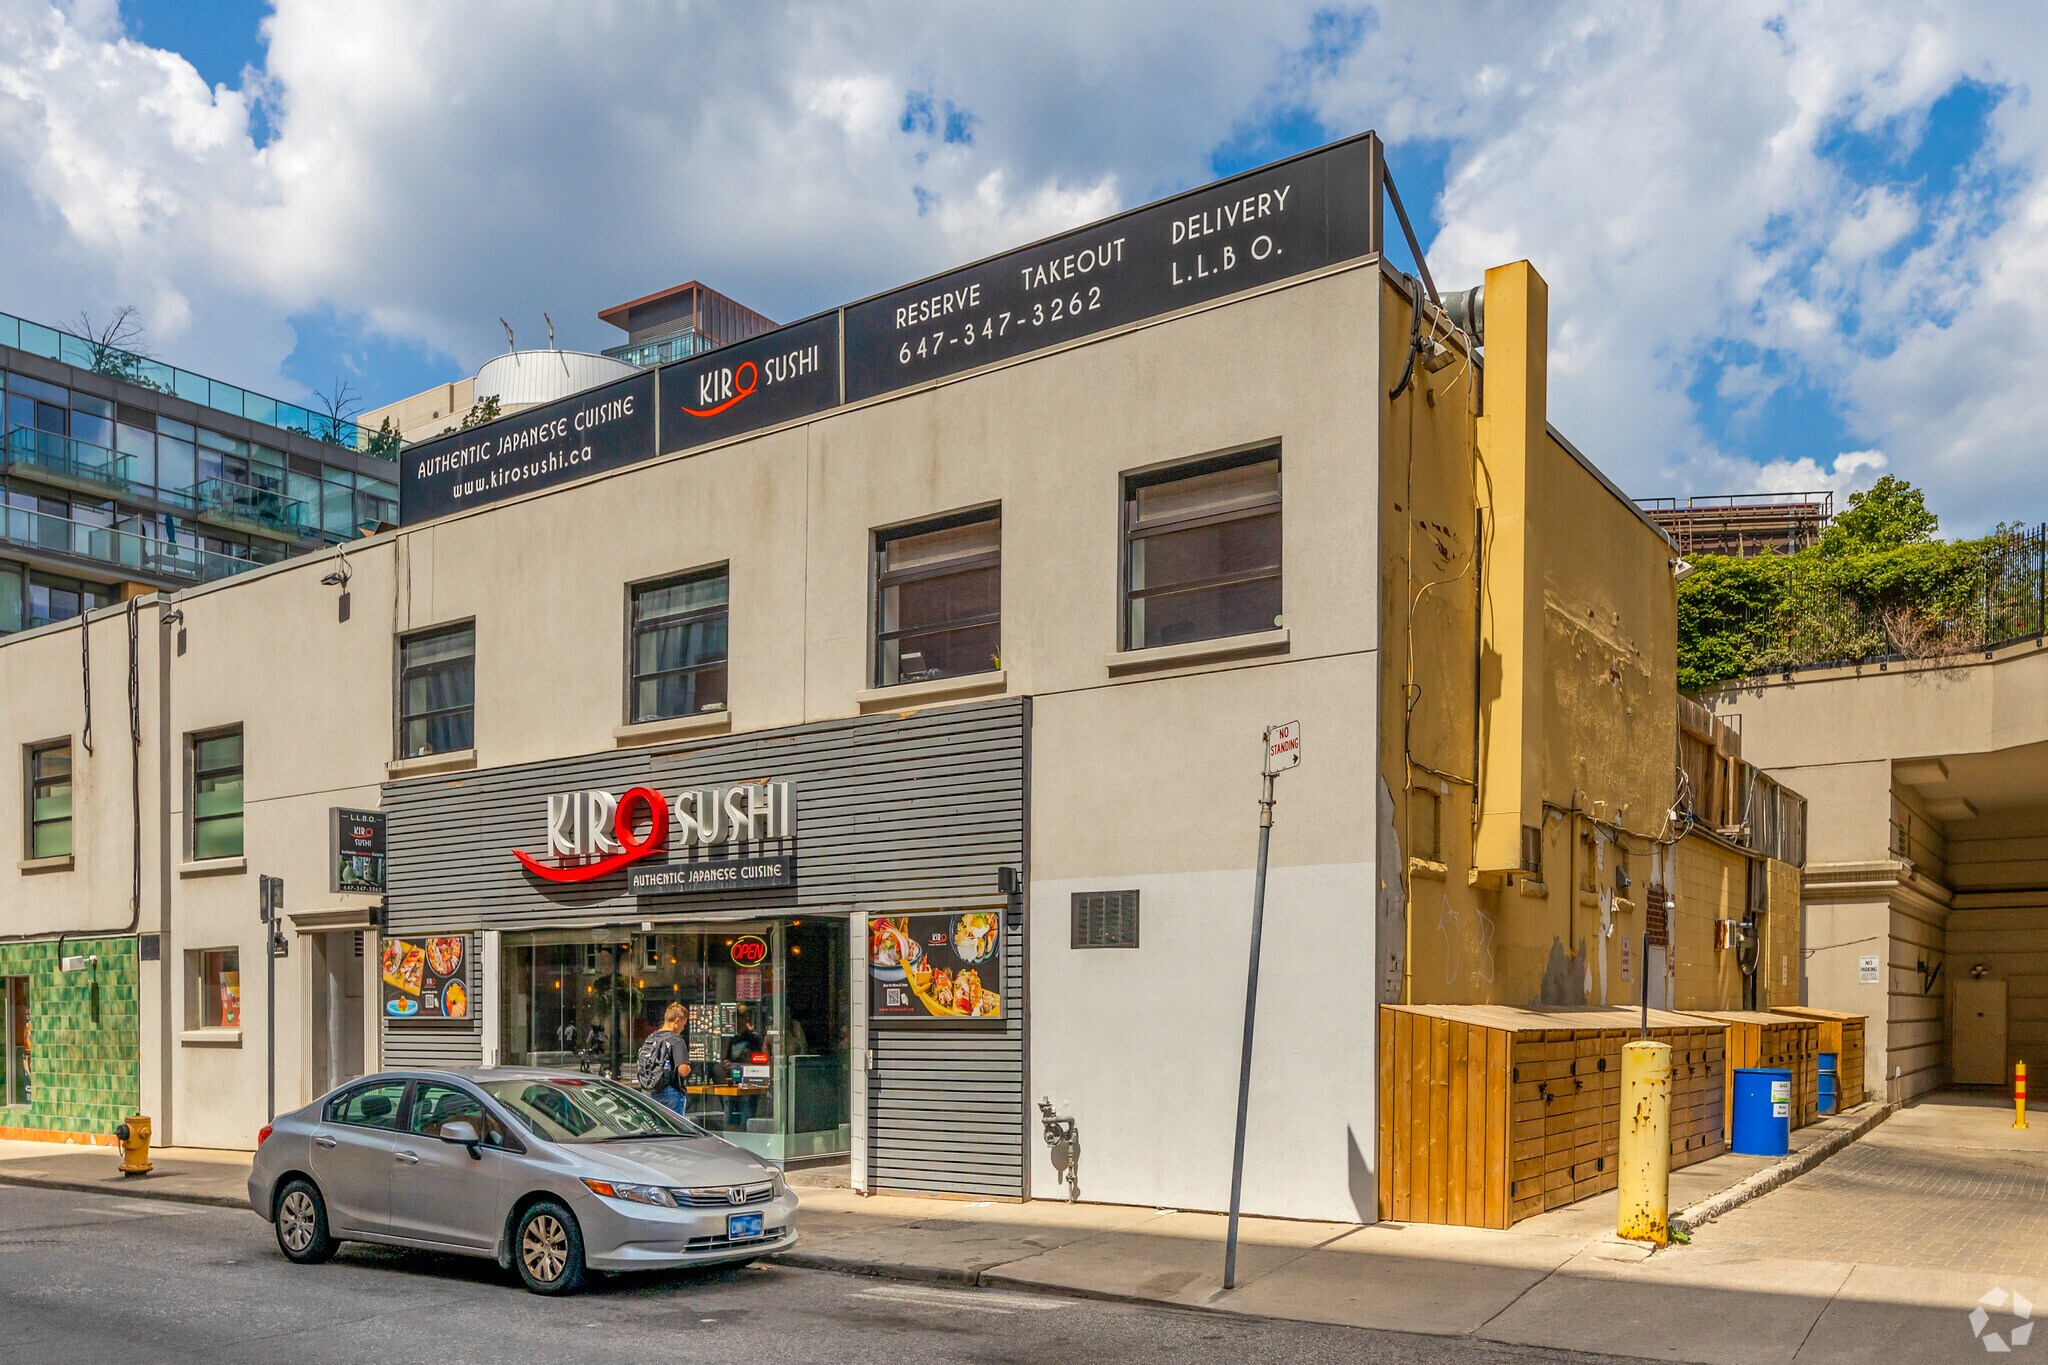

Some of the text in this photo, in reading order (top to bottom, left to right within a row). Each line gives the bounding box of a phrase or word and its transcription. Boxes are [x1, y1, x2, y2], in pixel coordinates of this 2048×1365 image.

[896, 185, 1292, 329] RESERVE TAKEOUT DELIVERY
[899, 286, 1102, 364] 647-347-3262
[681, 345, 819, 418] KIRO SUSHI
[417, 395, 635, 479] AUTHENTIC JAPANESE CUISINE
[453, 444, 593, 499] www.kirosushi.ca
[1271, 738, 1298, 756] STANDING
[1280, 727, 1289, 739] NO
[348, 826, 373, 838] KIRO
[354, 839, 372, 847] SUSHI
[511, 780, 798, 882] KIRO SUSHI
[633, 863, 782, 887] AUTHENTIC JAPANESE CUISINE
[733, 943, 764, 960] OPEN
